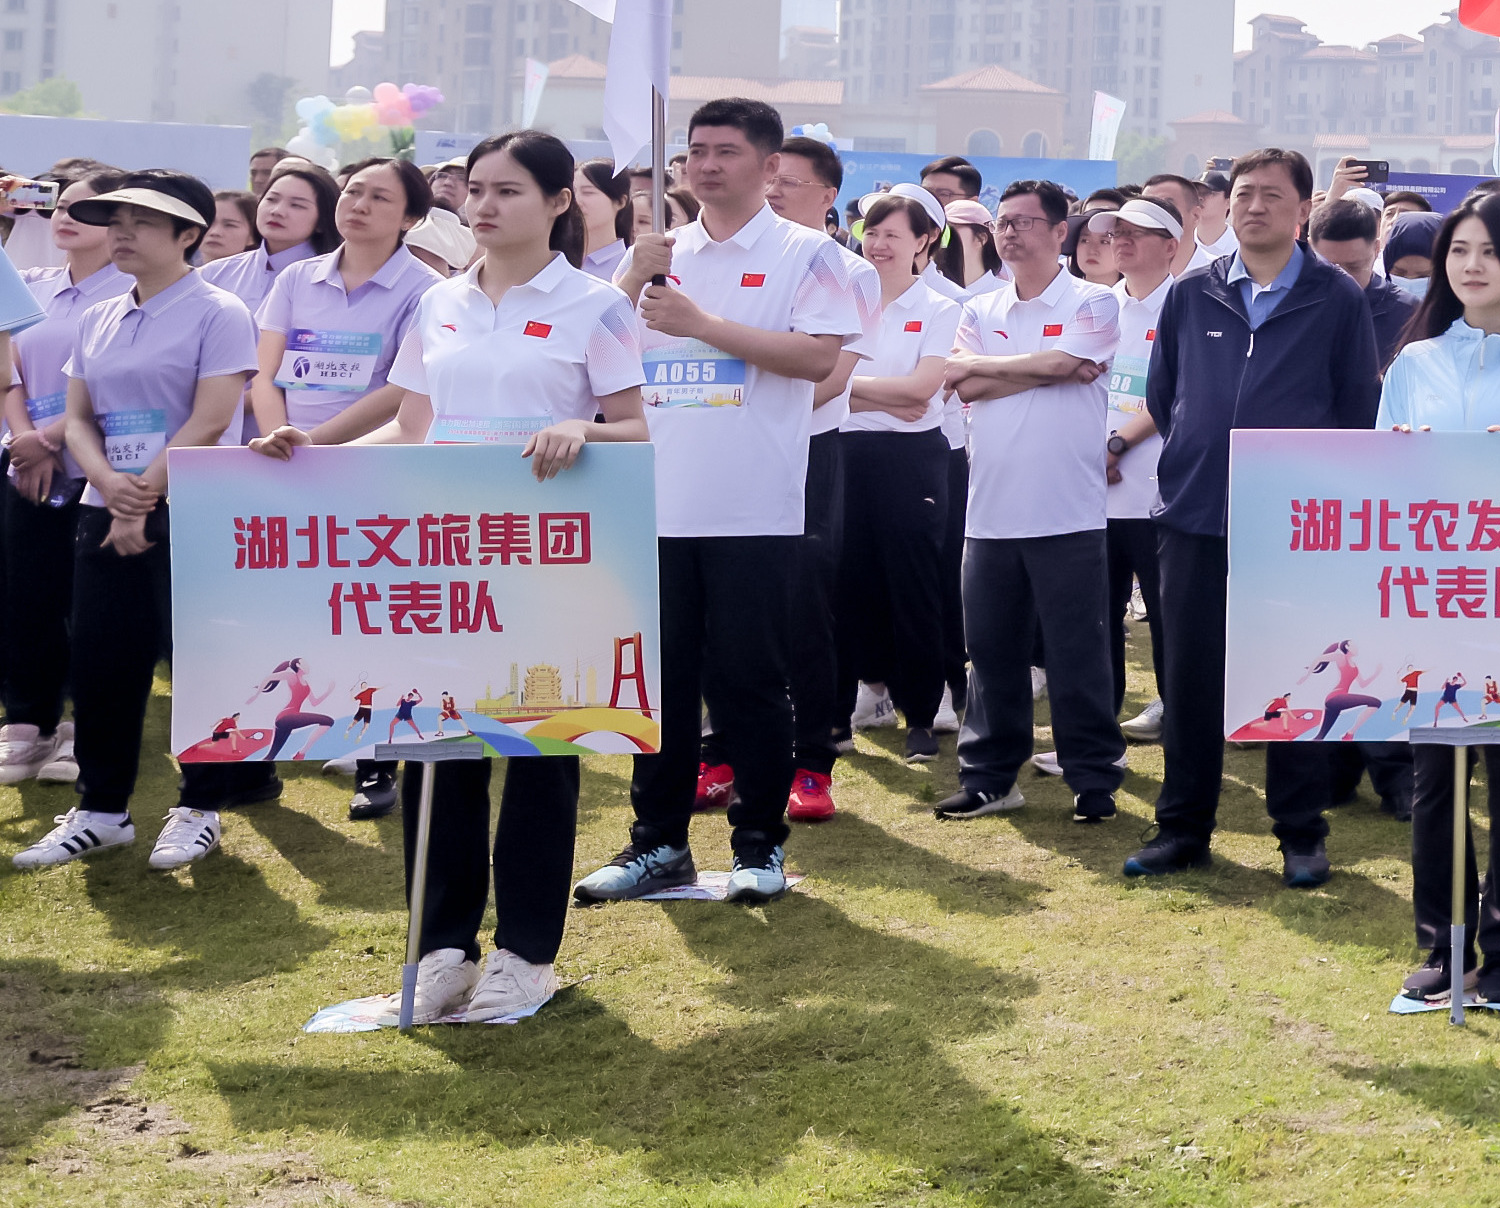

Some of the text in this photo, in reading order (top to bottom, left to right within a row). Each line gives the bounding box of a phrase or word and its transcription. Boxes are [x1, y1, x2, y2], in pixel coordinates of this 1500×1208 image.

[314, 361, 361, 372] 湖北交投
[654, 362, 716, 383] A055
[1109, 374, 1132, 392] 98
[233, 512, 592, 569] 湖北文旅集团
[327, 580, 504, 636] 代表队
